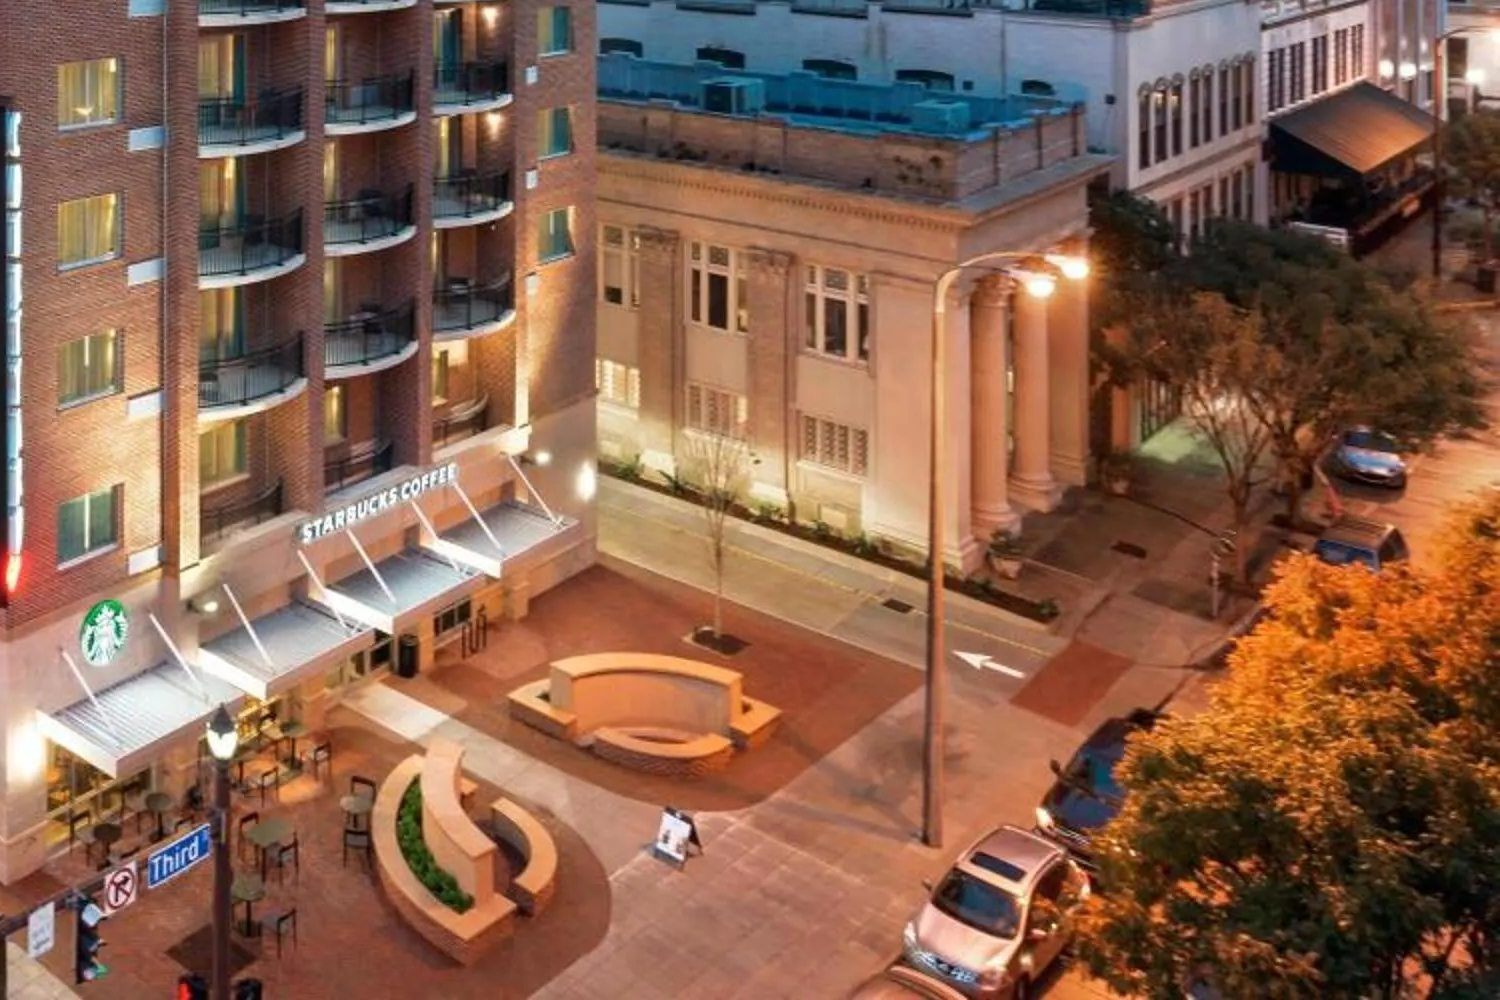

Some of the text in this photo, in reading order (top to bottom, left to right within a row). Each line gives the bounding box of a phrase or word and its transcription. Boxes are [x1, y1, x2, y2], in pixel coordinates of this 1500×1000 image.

[302, 462, 457, 543] STARBUCKS COFFEE
[151, 835, 199, 880] Third
